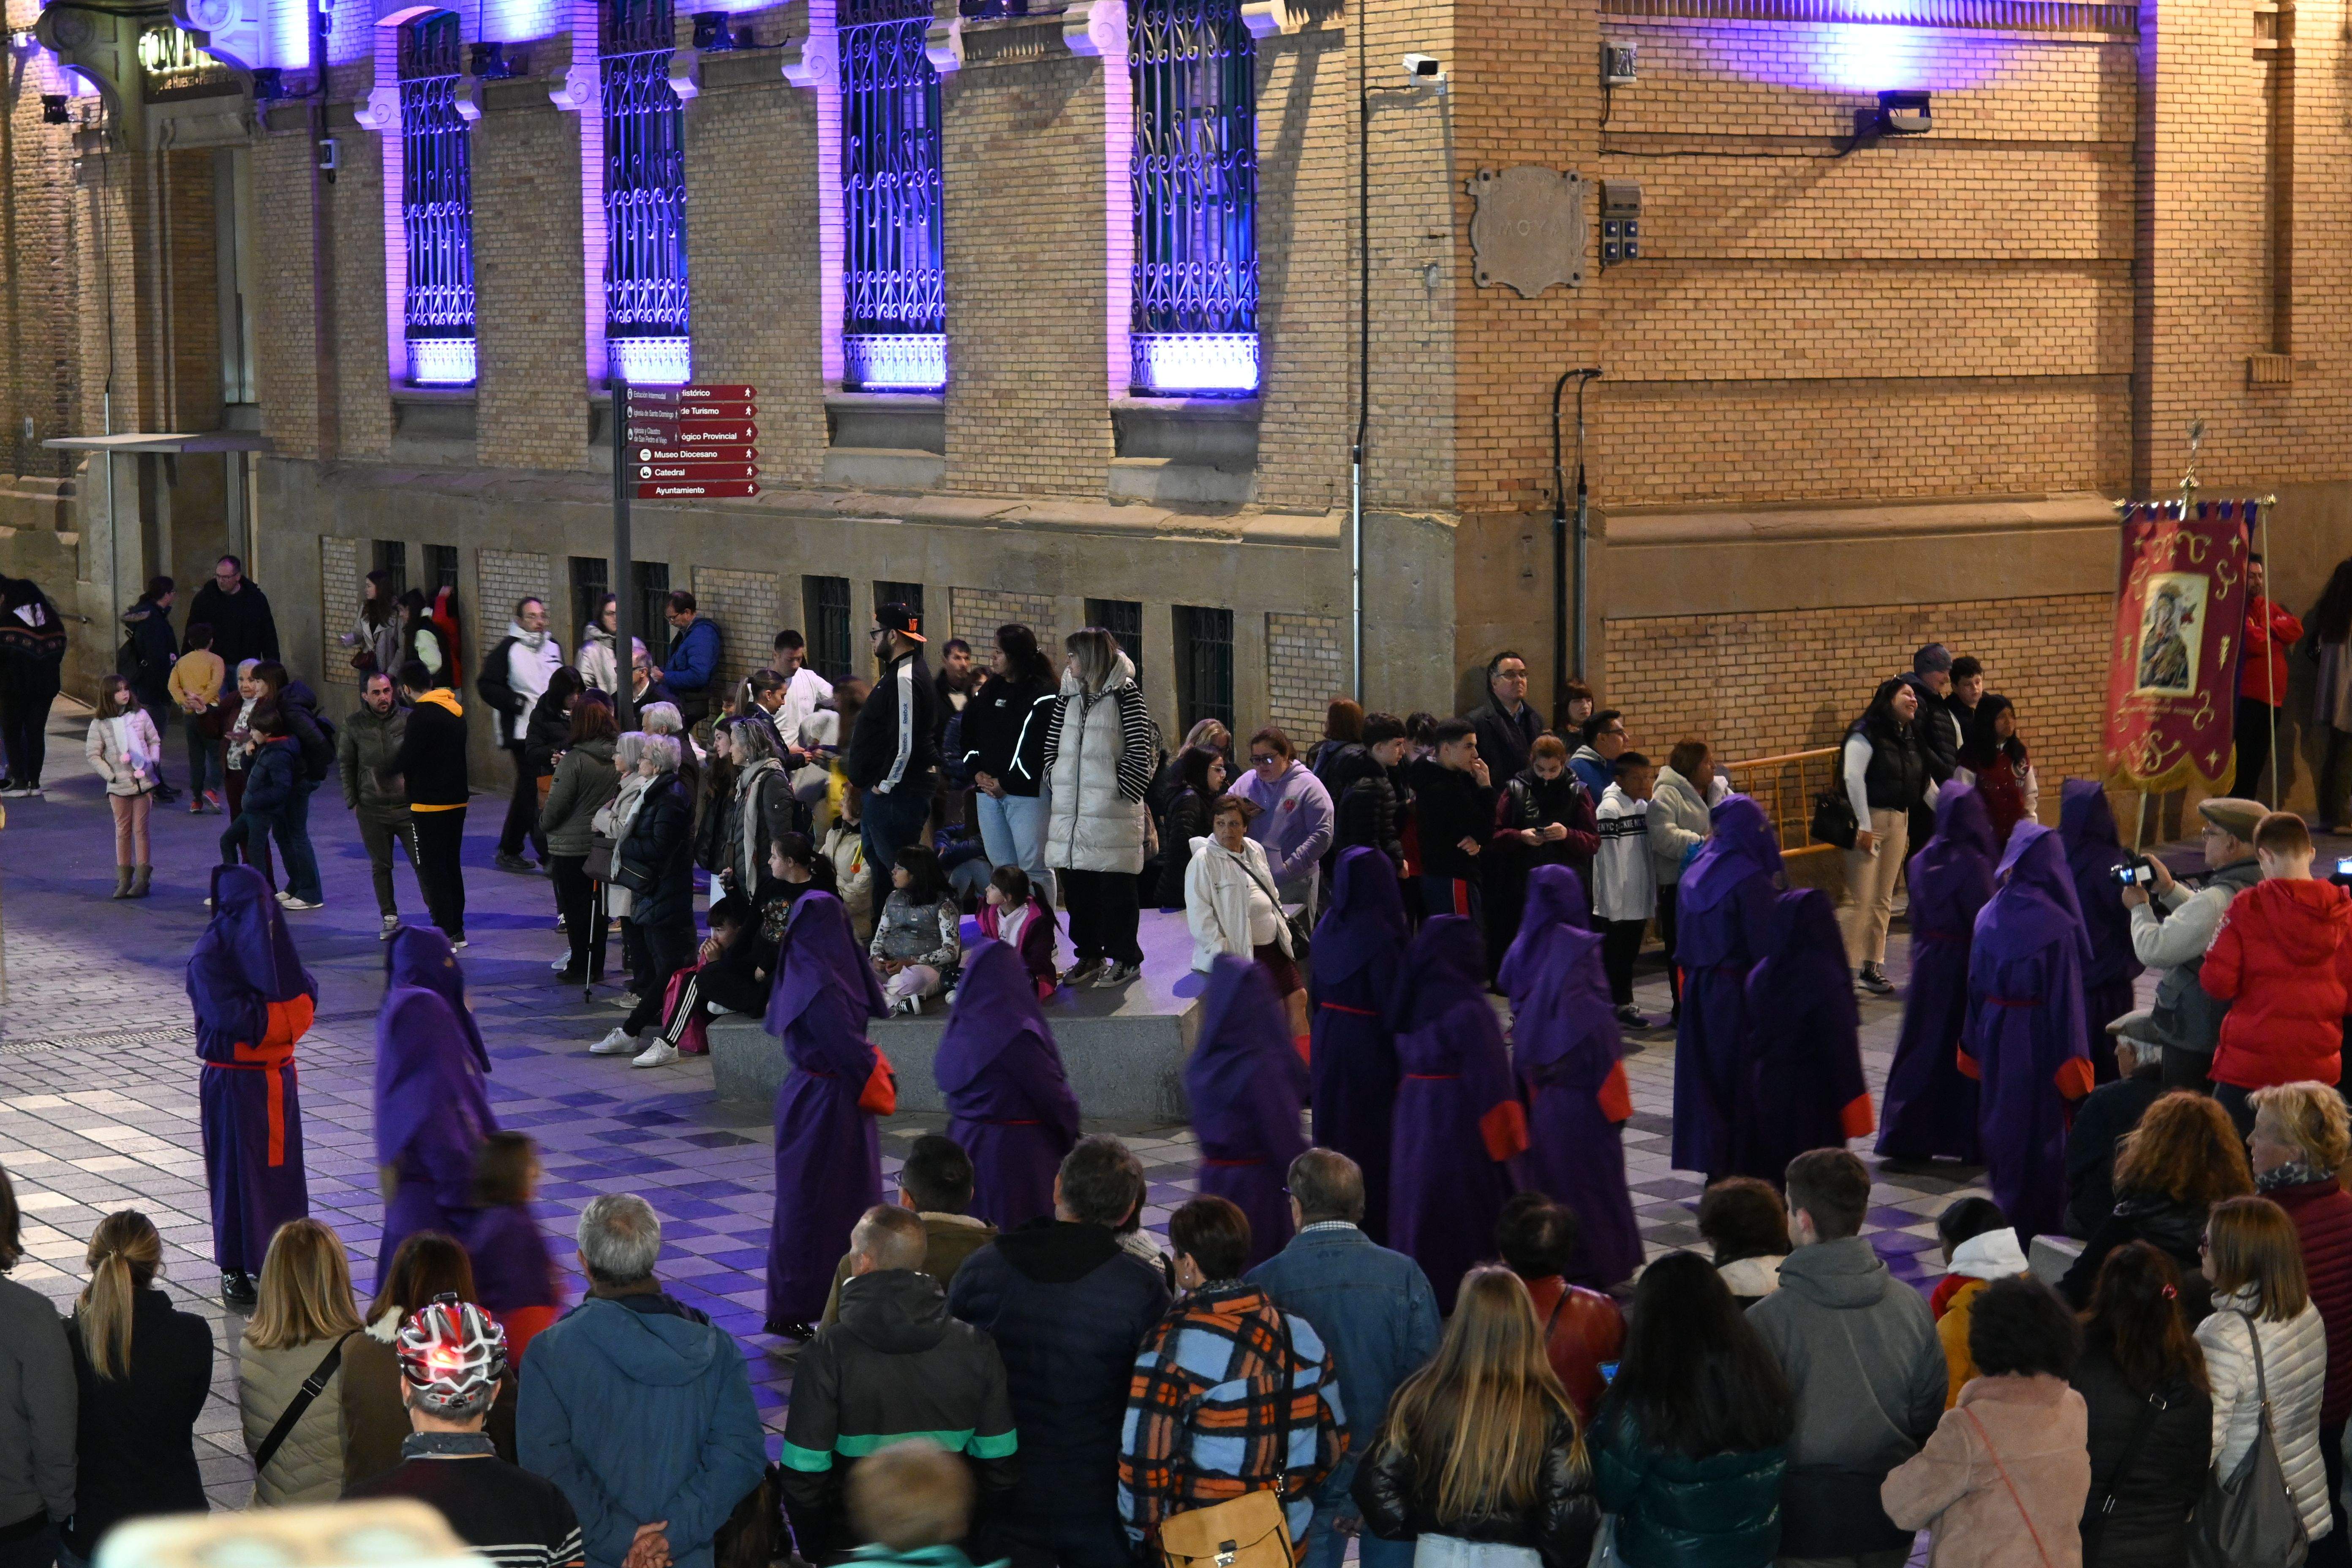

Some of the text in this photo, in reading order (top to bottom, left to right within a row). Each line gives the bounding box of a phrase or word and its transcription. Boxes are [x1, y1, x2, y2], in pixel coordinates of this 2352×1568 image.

[634, 409, 644, 417] Iglesia
[680, 450, 718, 458] Diocesano
[656, 487, 705, 495] Ayuntamiento
